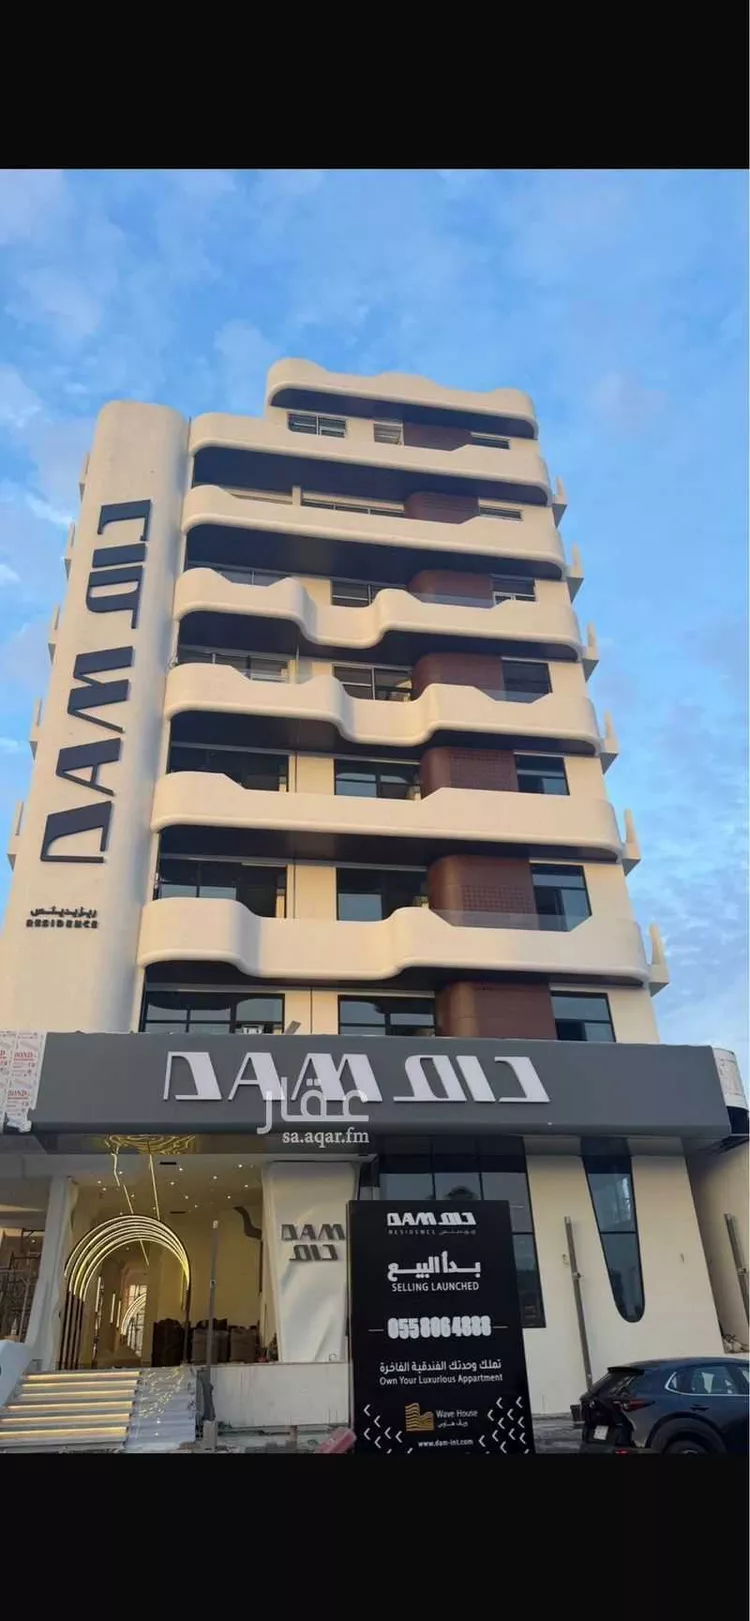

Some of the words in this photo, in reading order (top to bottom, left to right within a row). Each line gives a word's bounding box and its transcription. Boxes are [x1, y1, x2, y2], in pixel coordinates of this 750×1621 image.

[40, 645, 134, 864] DAM
[26, 919, 98, 929] RESIDENCE
[163, 1051, 383, 1101] DAM
[387, 1212, 437, 1226] DAM
[281, 1224, 346, 1240] DAM
[387, 1256, 440, 1282] البيع
[441, 1250, 481, 1278] بدأ
[392, 1282, 429, 1292] SELLING
[431, 1281, 480, 1291] LAUNCHED
[379, 1362, 410, 1375] الفاخرة
[411, 1361, 447, 1374] الفندقية
[448, 1360, 477, 1372] وحدتك
[478, 1359, 502, 1370] تملك
[379, 1376, 398, 1386] Own
[399, 1376, 417, 1385] Your
[418, 1374, 457, 1385] Luxurious
[458, 1373, 503, 1384] Appartment
[436, 1410, 455, 1418] Wave
[456, 1409, 478, 1417] House
